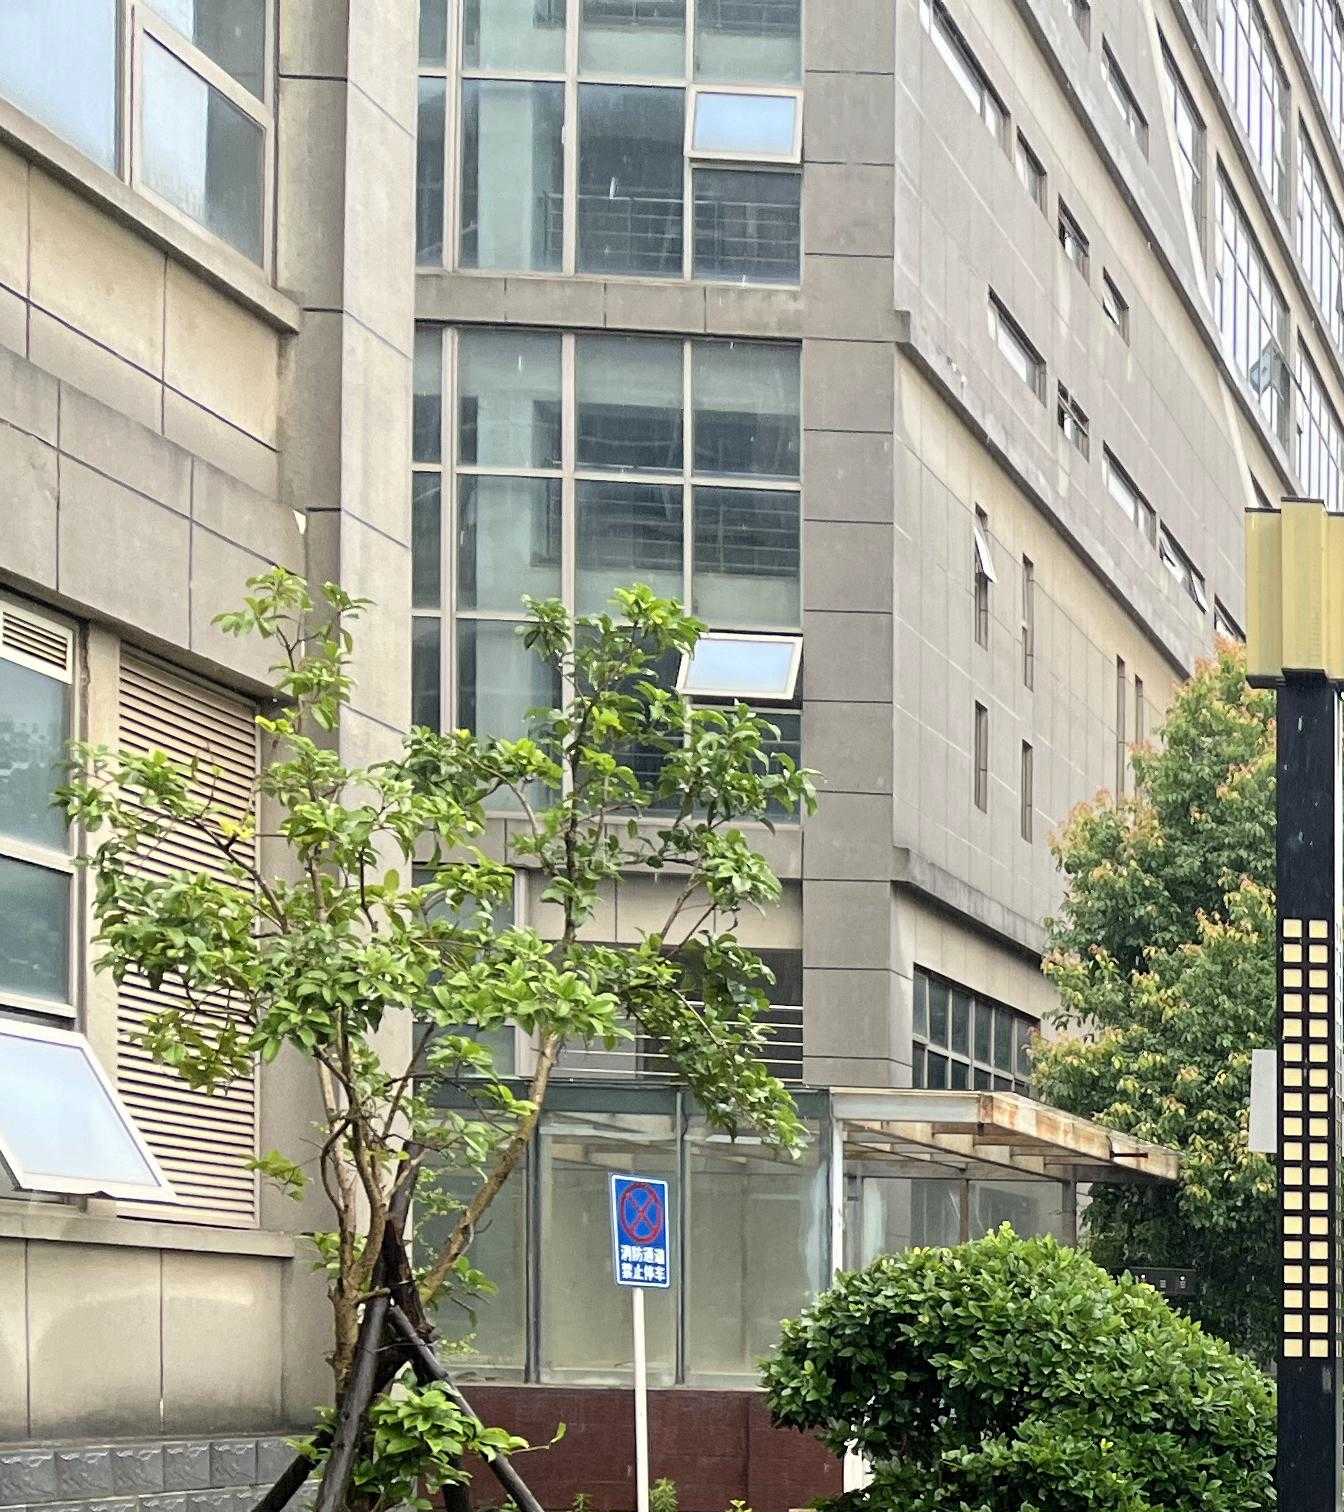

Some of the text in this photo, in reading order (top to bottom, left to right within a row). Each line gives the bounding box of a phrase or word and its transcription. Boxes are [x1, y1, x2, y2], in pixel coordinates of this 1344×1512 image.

[620, 1245, 665, 1265] 消防通道
[621, 1262, 666, 1281] 禁止停车
